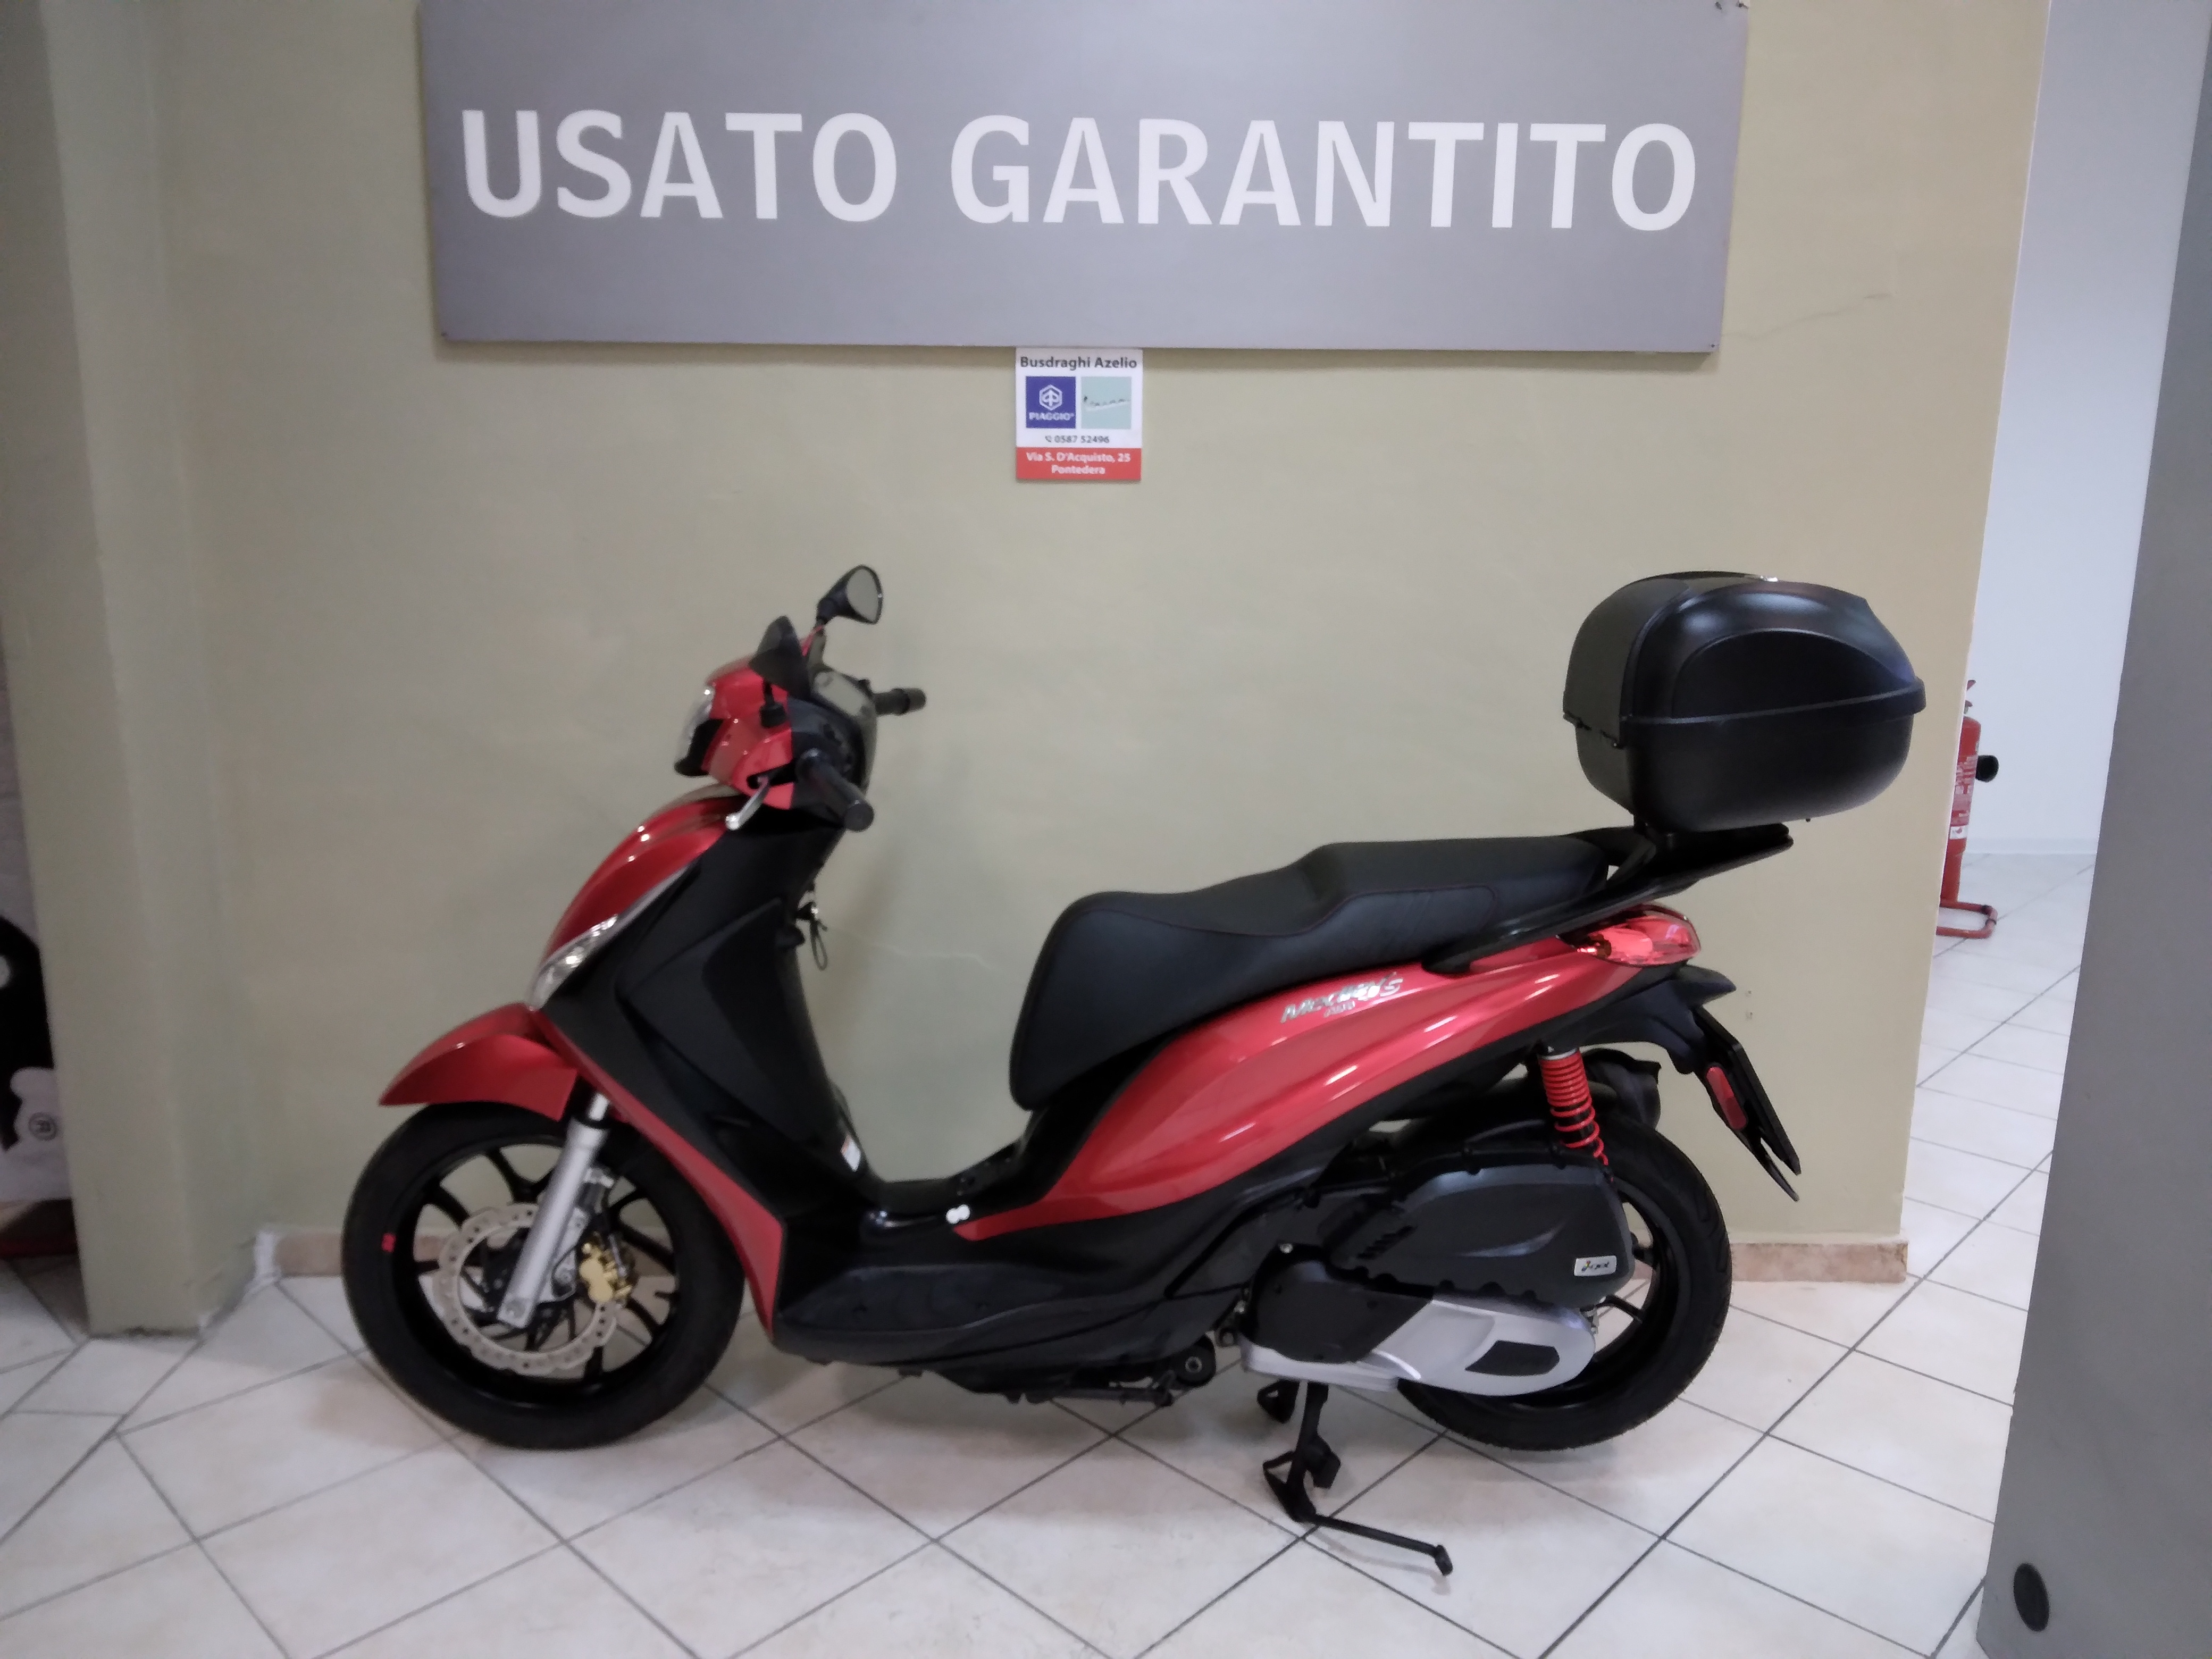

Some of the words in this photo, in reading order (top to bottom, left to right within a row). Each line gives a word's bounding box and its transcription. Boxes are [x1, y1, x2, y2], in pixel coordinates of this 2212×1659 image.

[462, 109, 898, 222] USATO
[950, 114, 1696, 232] GARANTITO
[1020, 356, 1090, 371] Busdraghi
[1094, 356, 1137, 368] Azelio
[1054, 435, 1078, 443] 0587
[1080, 435, 1110, 443] 52496
[1026, 451, 1043, 462] Via
[1045, 452, 1055, 462] S.
[1117, 453, 1131, 463] 25
[1051, 464, 1105, 474] Pontedera
